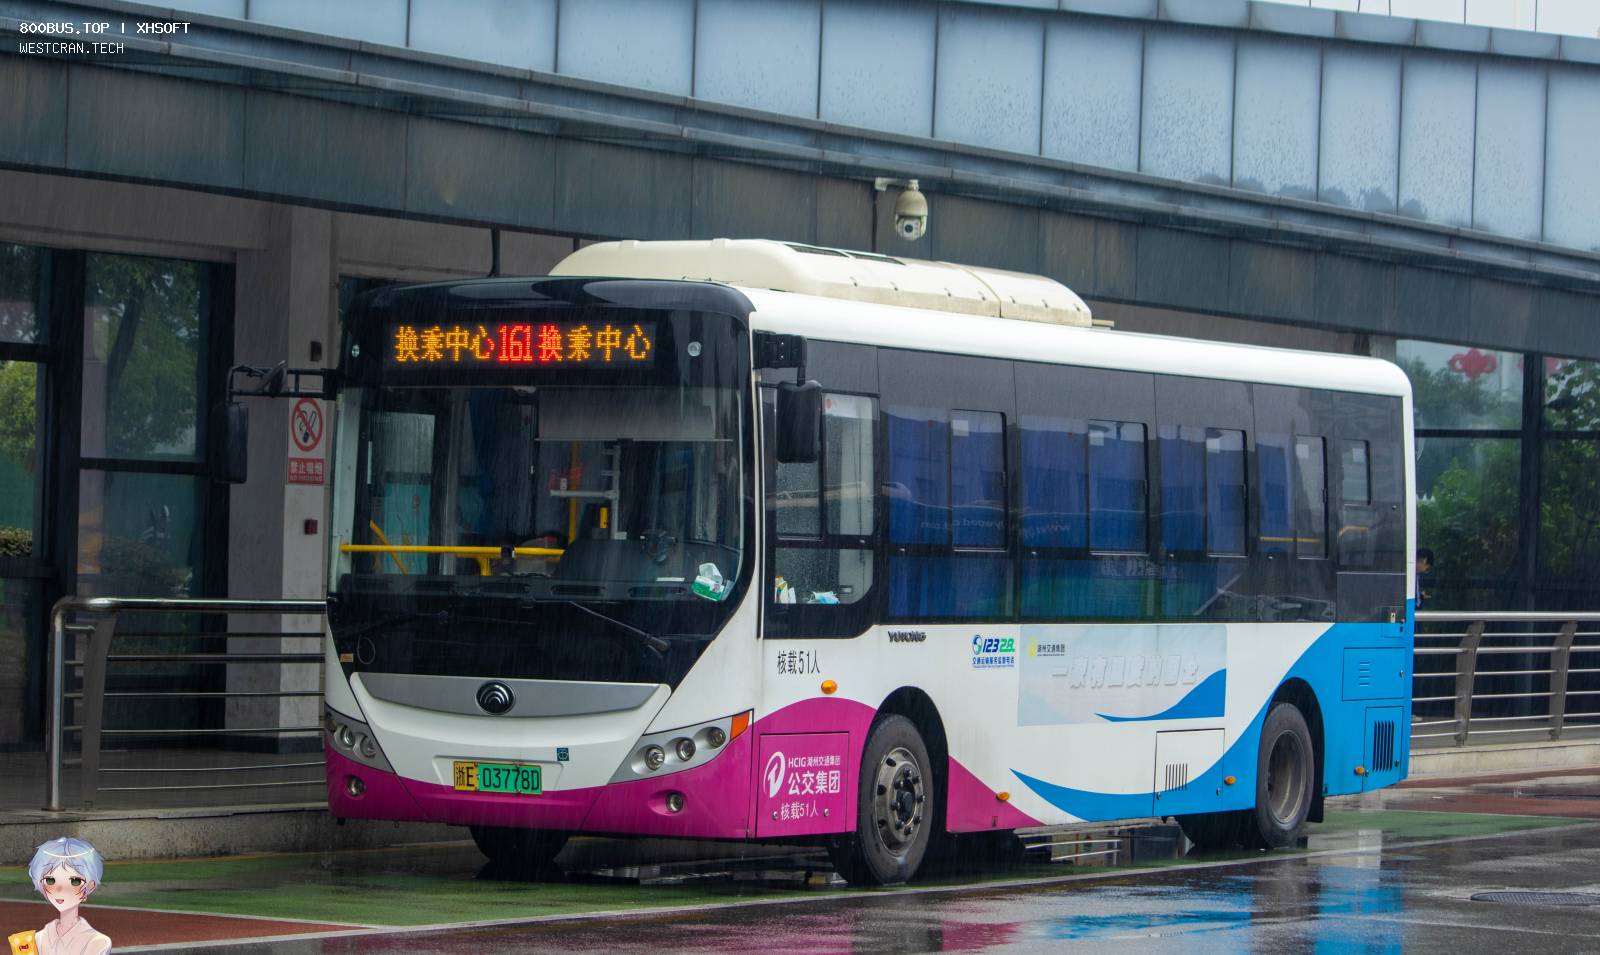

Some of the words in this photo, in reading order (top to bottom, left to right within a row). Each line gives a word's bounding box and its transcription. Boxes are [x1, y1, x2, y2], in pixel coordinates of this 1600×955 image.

[777, 649, 821, 675] 核载51人
[788, 756, 807, 769] HCIG
[788, 770, 841, 795] 公交集团
[781, 800, 819, 820] 核载51人
